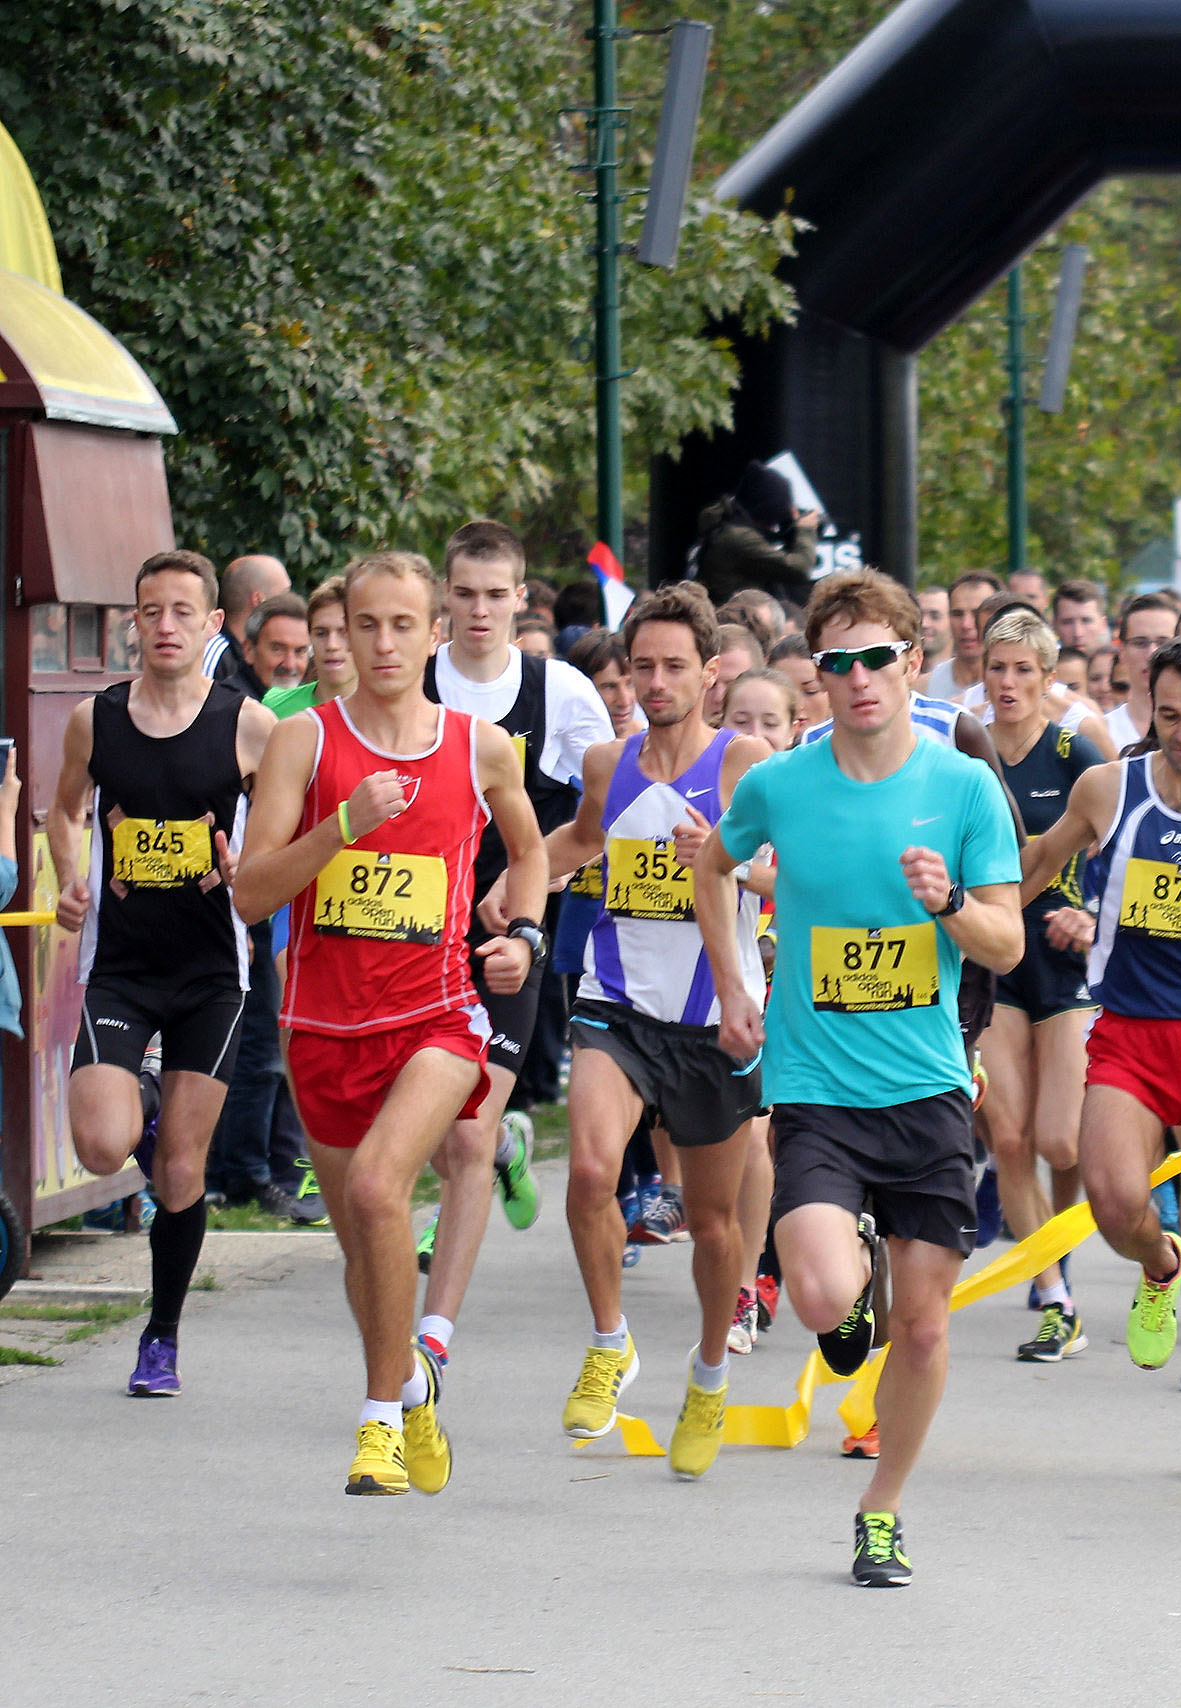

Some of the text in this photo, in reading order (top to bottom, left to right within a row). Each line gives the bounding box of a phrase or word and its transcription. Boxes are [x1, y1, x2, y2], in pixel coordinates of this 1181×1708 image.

[136, 830, 184, 854] 845
[633, 852, 688, 882] 352
[351, 865, 413, 898] 872
[347, 897, 383, 907] adidas
[361, 907, 395, 918] open
[372, 918, 395, 927] run
[843, 940, 906, 970] 877
[843, 973, 879, 982] adidas
[857, 981, 893, 992] open
[871, 990, 893, 1000] run
